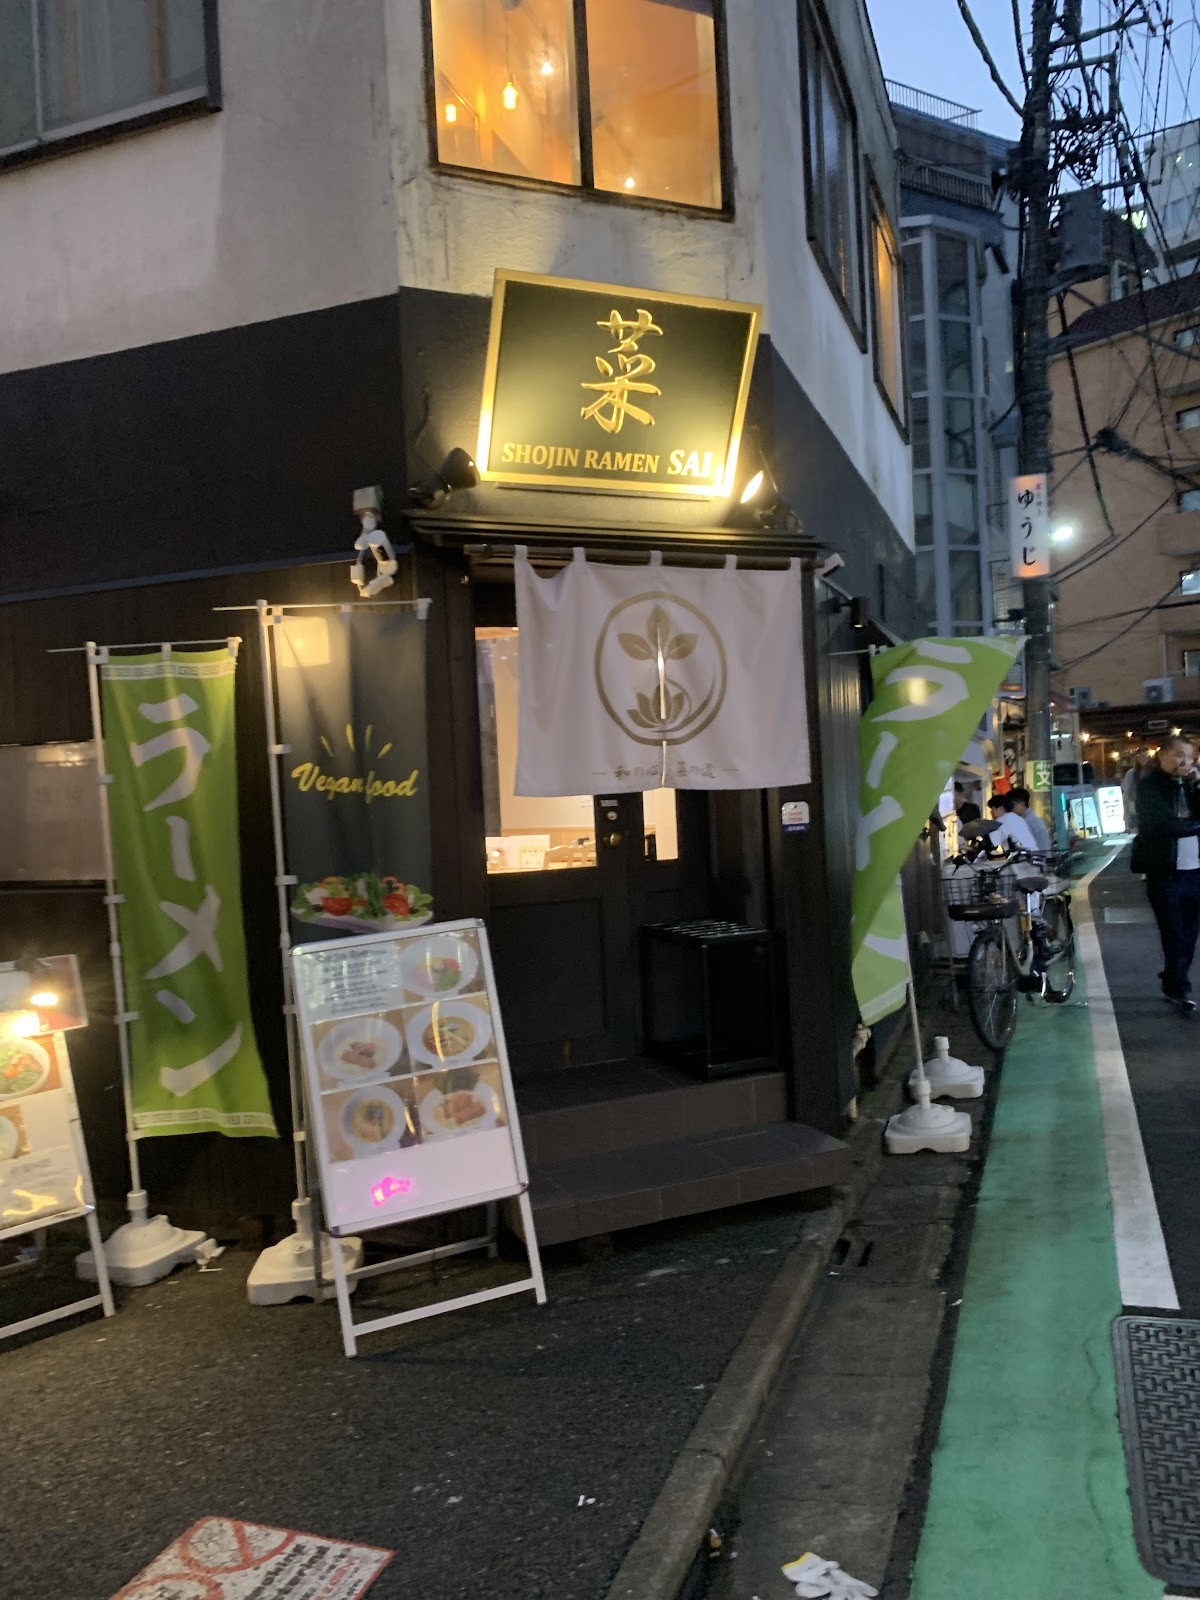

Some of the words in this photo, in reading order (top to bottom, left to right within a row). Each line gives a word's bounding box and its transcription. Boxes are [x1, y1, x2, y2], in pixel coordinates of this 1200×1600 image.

[581, 309, 663, 433] 菜
[502, 443, 579, 469] SHOJIN
[584, 449, 660, 473] RAMEN
[667, 450, 714, 477] SAI
[1018, 489, 1036, 566] ゆうじ
[129, 692, 244, 1097] ラーメン
